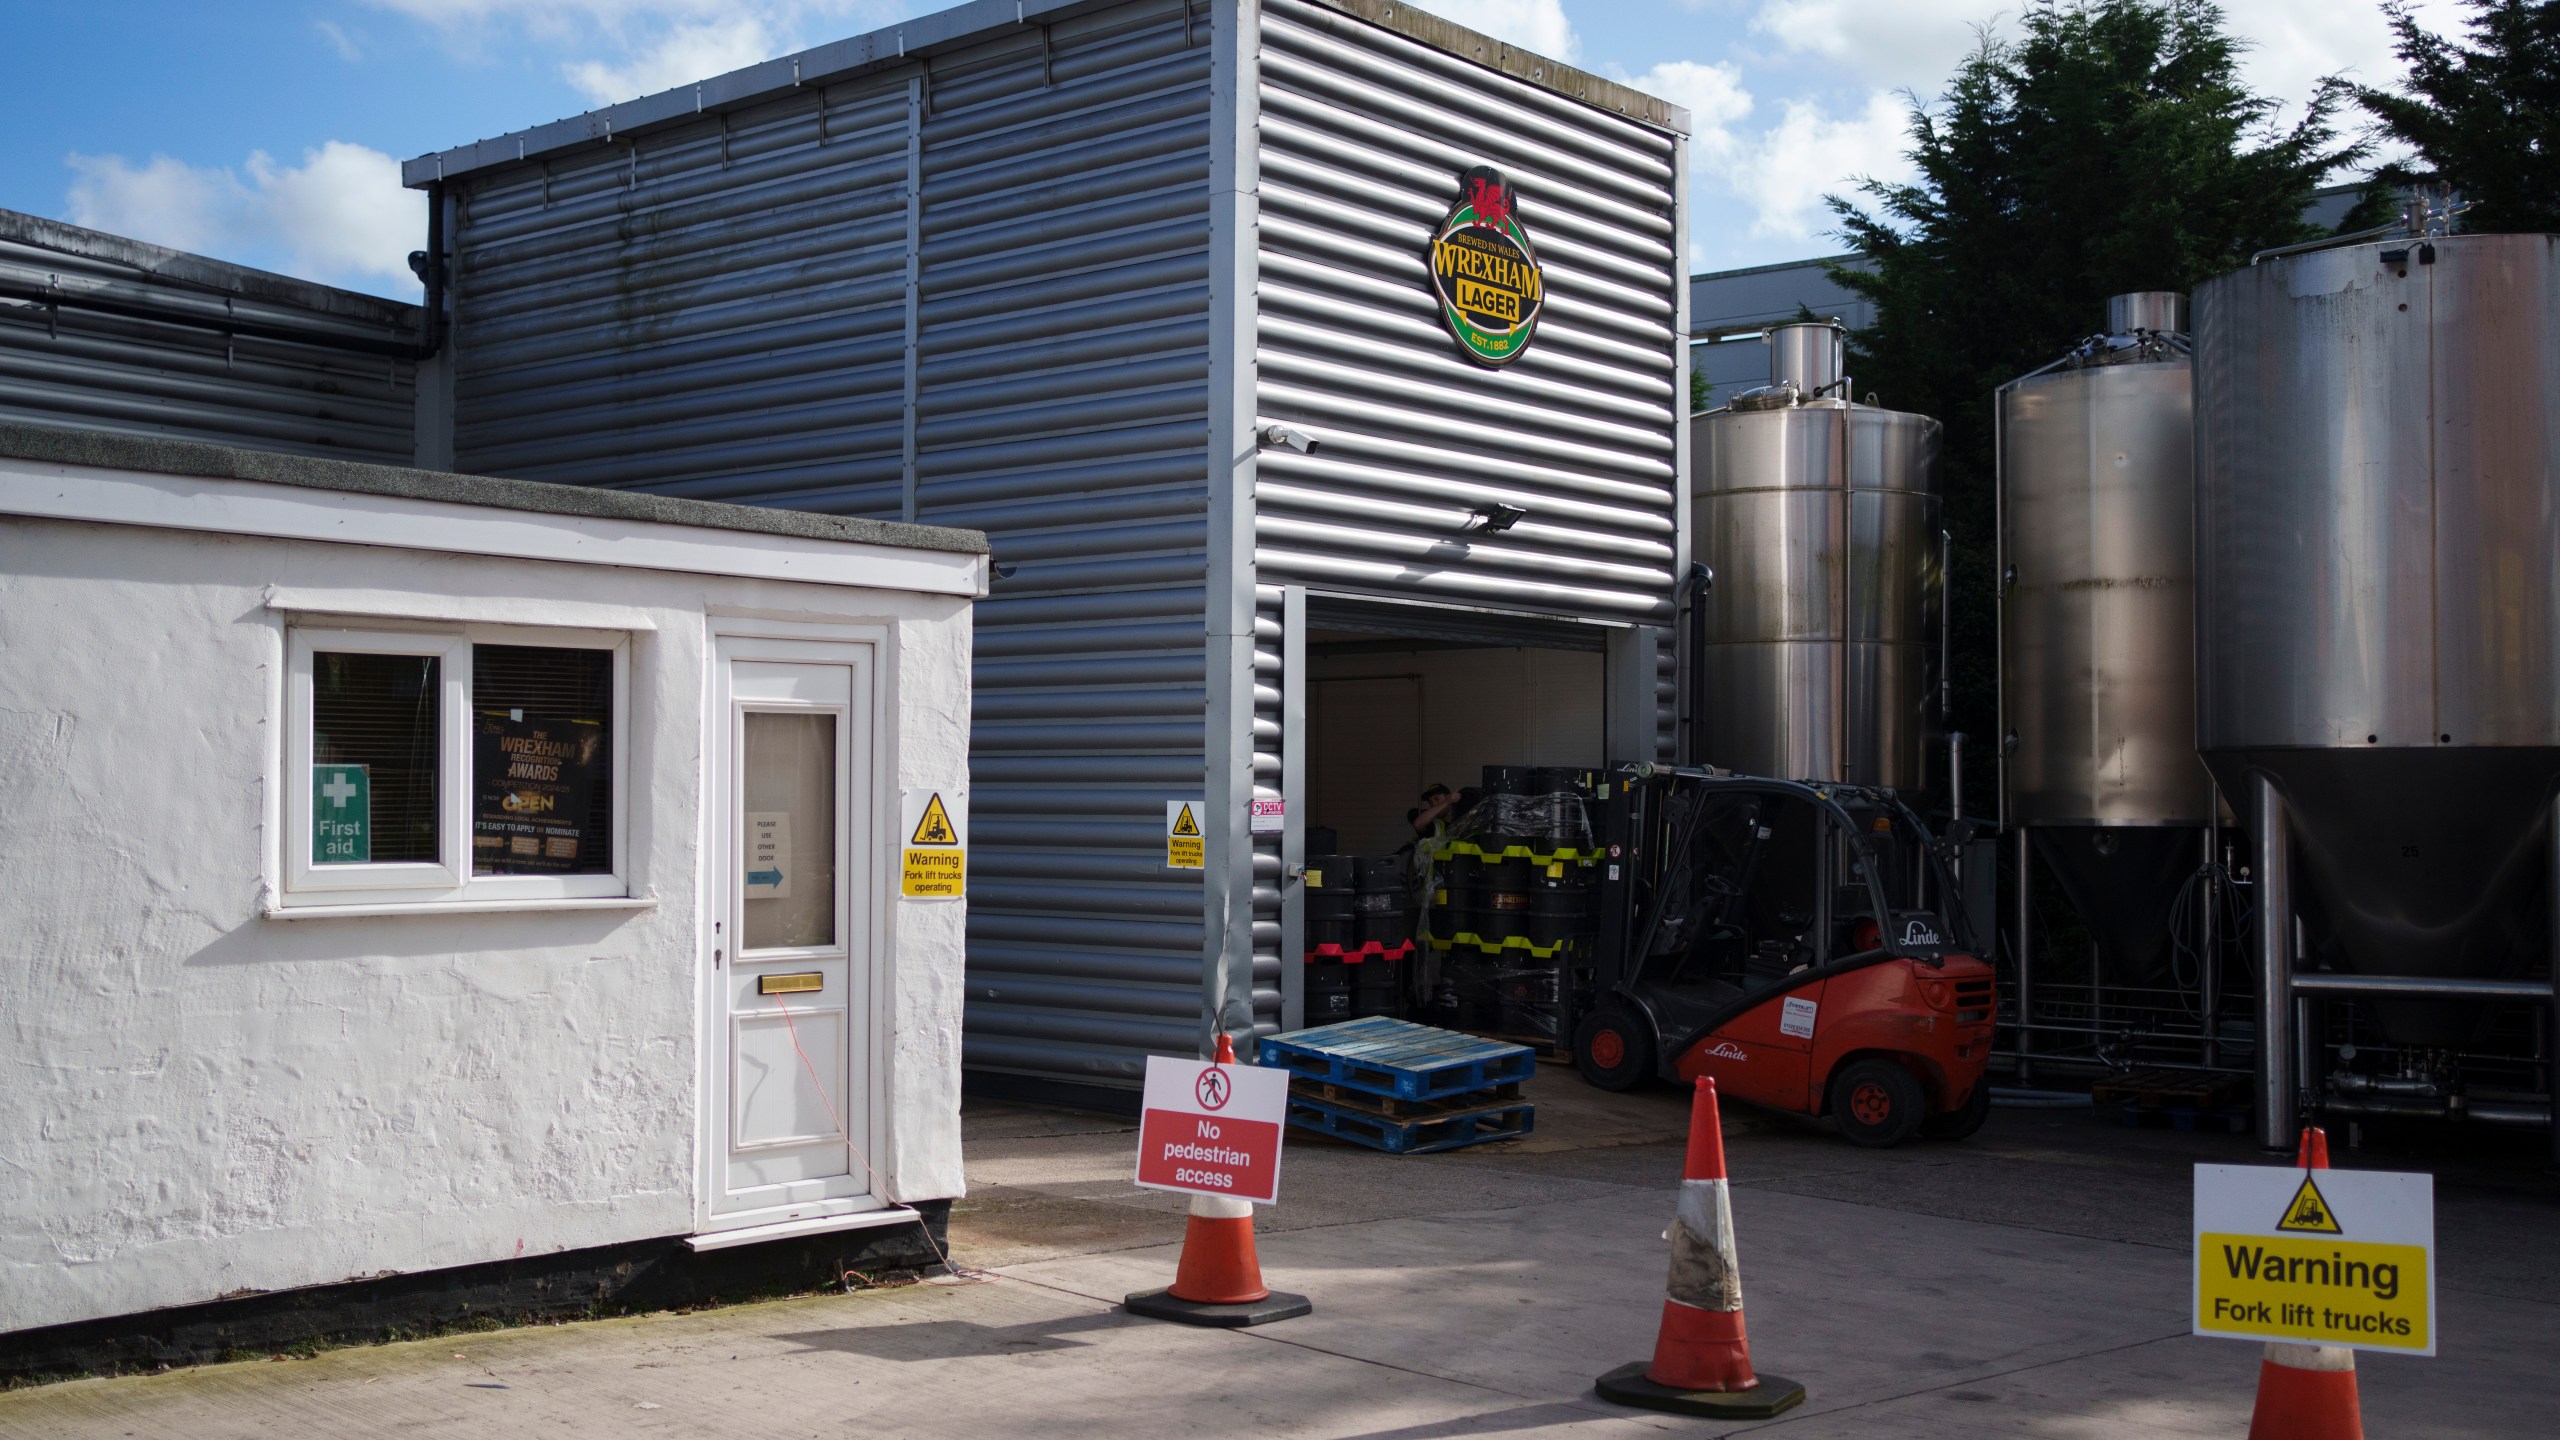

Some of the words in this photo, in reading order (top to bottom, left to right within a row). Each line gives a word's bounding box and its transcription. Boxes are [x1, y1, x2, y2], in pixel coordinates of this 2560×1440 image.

[1457, 233, 1488, 251] BREWED
[1498, 244, 1520, 260] WALES
[1434, 239, 1541, 302] WREXHAM
[1462, 284, 1516, 318] LAGER
[533, 730, 548, 740] THE
[500, 736, 576, 758] WREXHAM
[511, 753, 561, 765] RECOGNITION
[508, 762, 559, 781] AWARDS
[1263, 803, 1282, 811] CCTV
[319, 820, 361, 836] First
[475, 821, 487, 830] IT'S
[488, 822, 505, 831] EASY
[506, 823, 515, 831] TO
[516, 824, 536, 833] APPLY
[546, 827, 580, 836] NOMINATE
[326, 838, 354, 854] aid
[1172, 839, 1201, 850] Warning
[2402, 846, 2419, 857] 25
[909, 853, 959, 869] Warning
[1176, 857, 1198, 865] operating
[904, 870, 923, 880] Fork
[925, 870, 936, 880] lift
[937, 870, 962, 880] trucks
[914, 882, 952, 893] operating
[1899, 920, 1941, 946] Linde
[1704, 1042, 1748, 1061] Linde
[1197, 1120, 1220, 1139] No
[1164, 1142, 1250, 1166] pedestrian
[1176, 1167, 1233, 1188] access
[2223, 1244, 2398, 1300] Warning
[2214, 1297, 2272, 1324] Fork
[2281, 1302, 2314, 1327] lift
[2323, 1307, 2411, 1336] trucks
